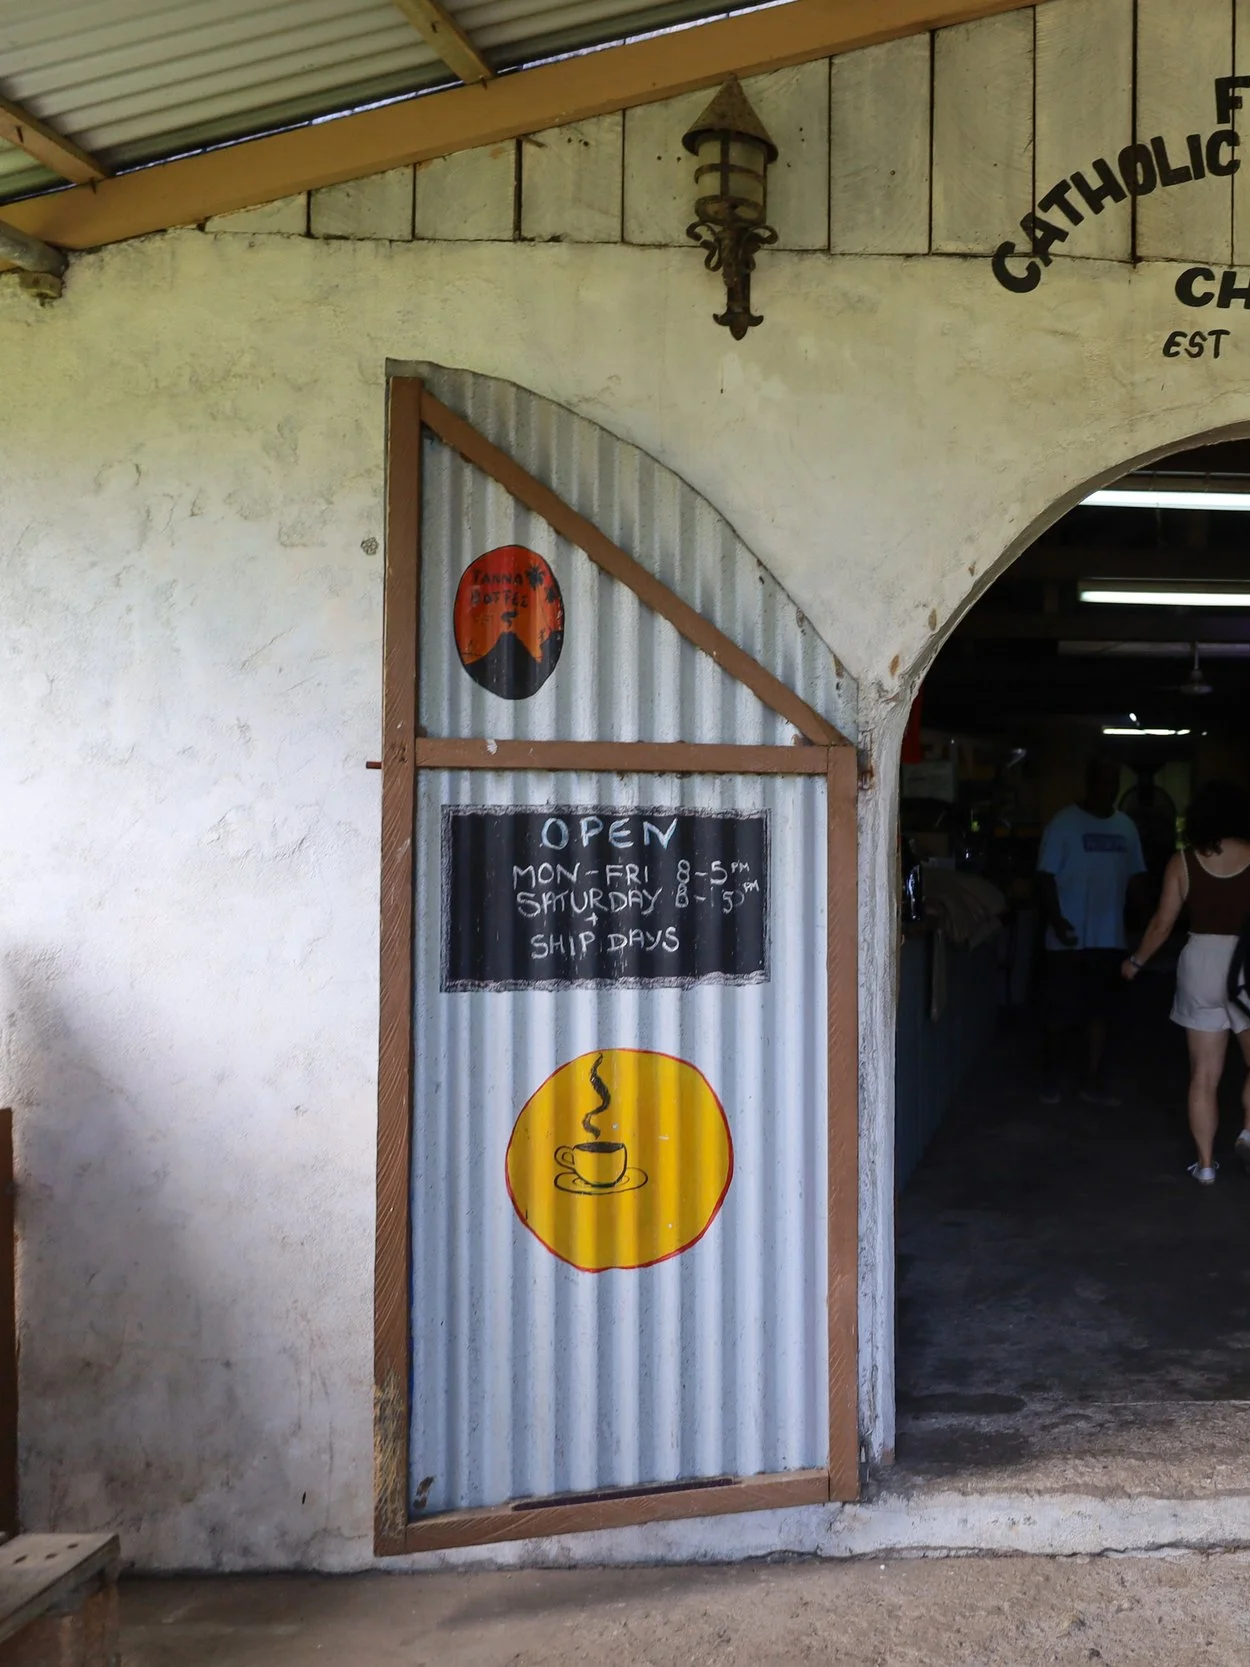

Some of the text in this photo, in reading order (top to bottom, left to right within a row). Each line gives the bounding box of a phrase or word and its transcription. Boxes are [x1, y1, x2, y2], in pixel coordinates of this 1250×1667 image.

[991, 130, 1241, 293] CATHOLIC
[1162, 328, 1230, 359] EST
[540, 816, 678, 850] OPEN
[516, 886, 664, 918] SATURDAY
[530, 926, 681, 960] SHIP DAYS
